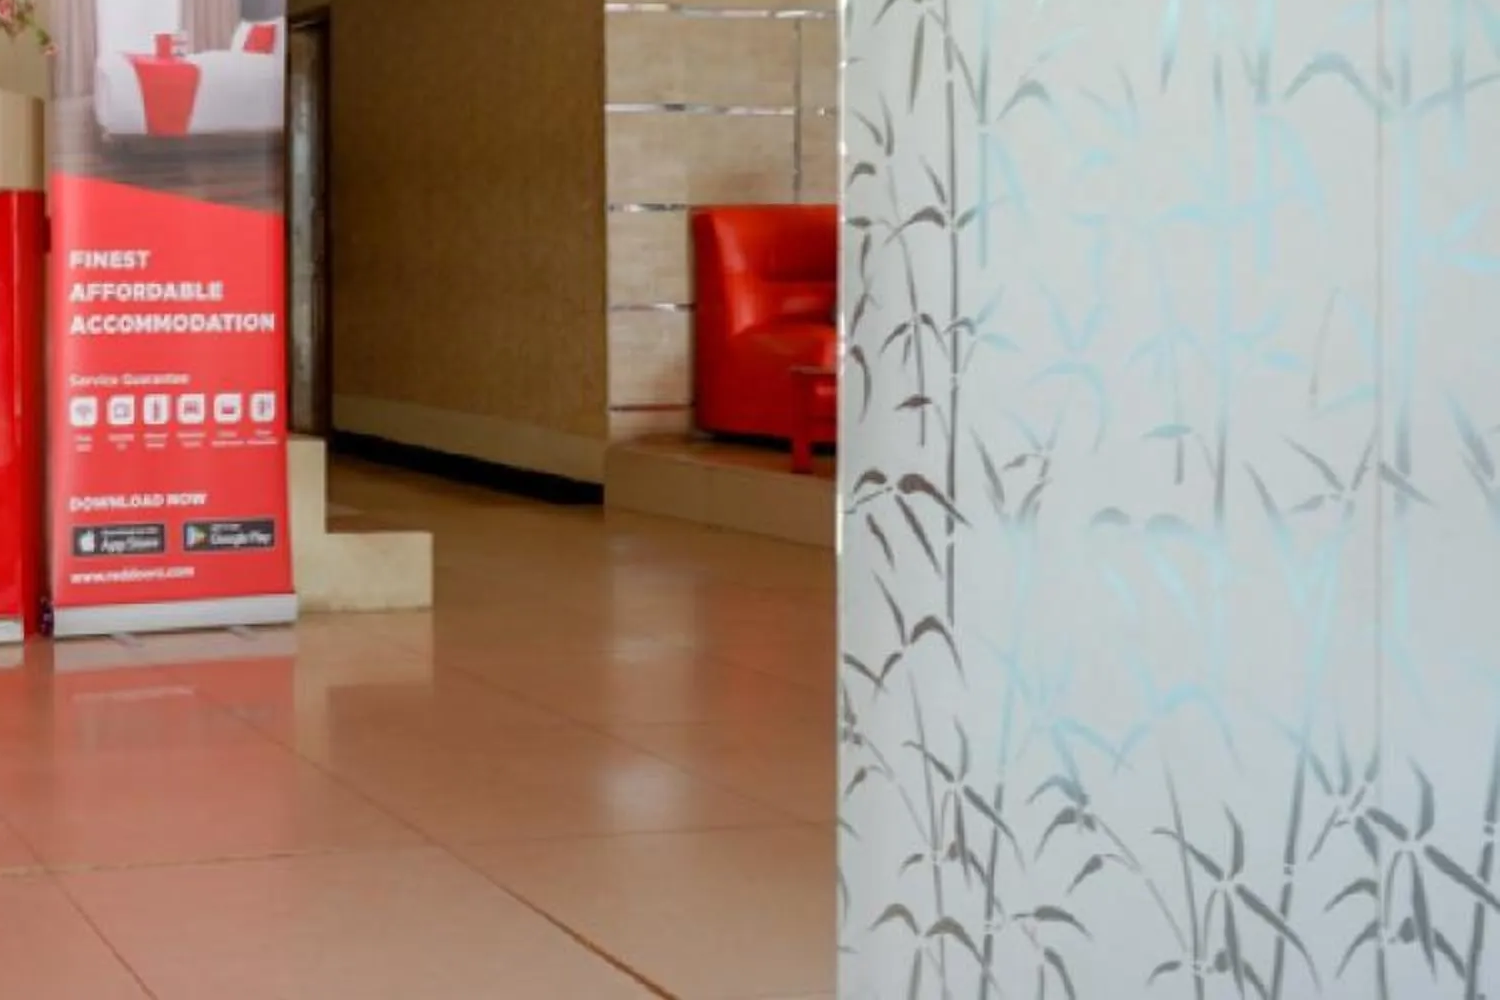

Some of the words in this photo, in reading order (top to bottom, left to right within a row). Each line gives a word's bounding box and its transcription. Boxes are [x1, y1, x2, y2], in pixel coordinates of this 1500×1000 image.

[69, 250, 150, 269] FINEST
[70, 281, 224, 301] AFFORDABLE
[70, 313, 276, 335] ACCOMMODATION
[70, 494, 164, 511] DOWNLOAD
[167, 493, 208, 506] NOW
